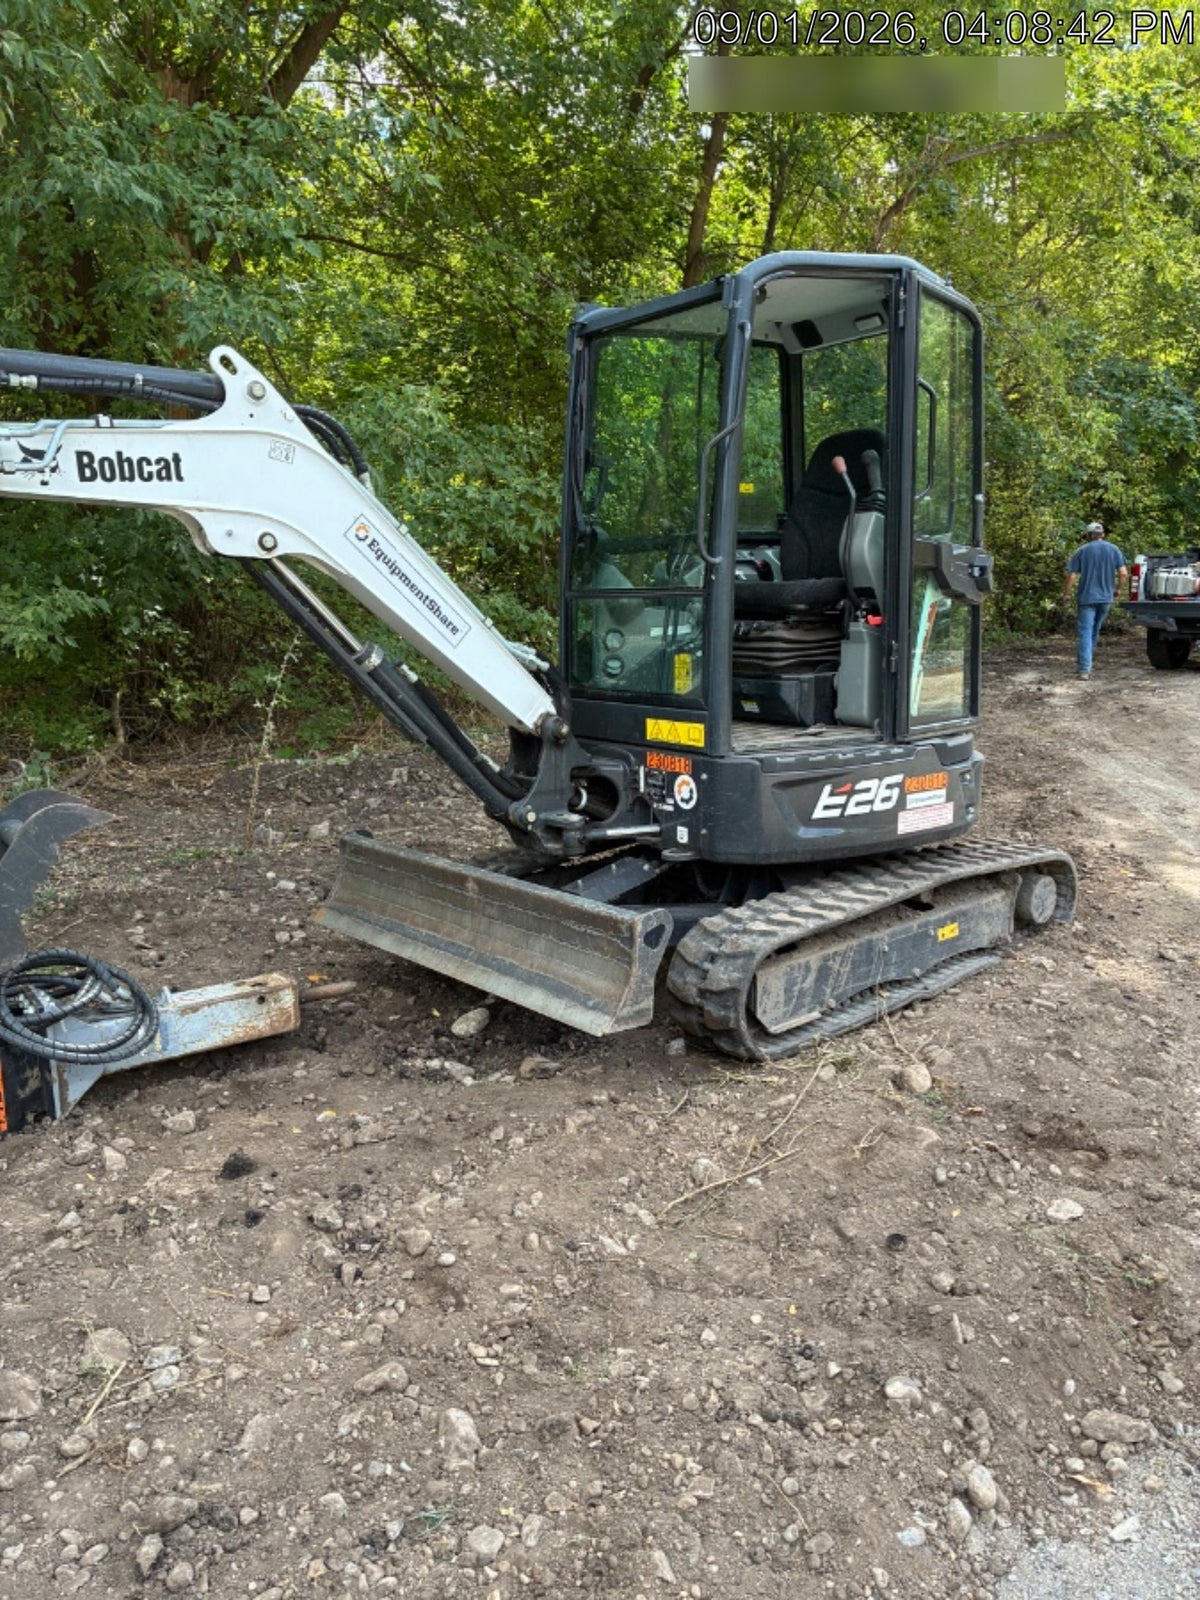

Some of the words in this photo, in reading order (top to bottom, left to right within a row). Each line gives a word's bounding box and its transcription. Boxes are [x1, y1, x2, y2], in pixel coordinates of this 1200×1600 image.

[75, 450, 184, 482] Bobcat
[367, 537, 460, 636] EquipmentShare
[811, 774, 904, 820] E26
